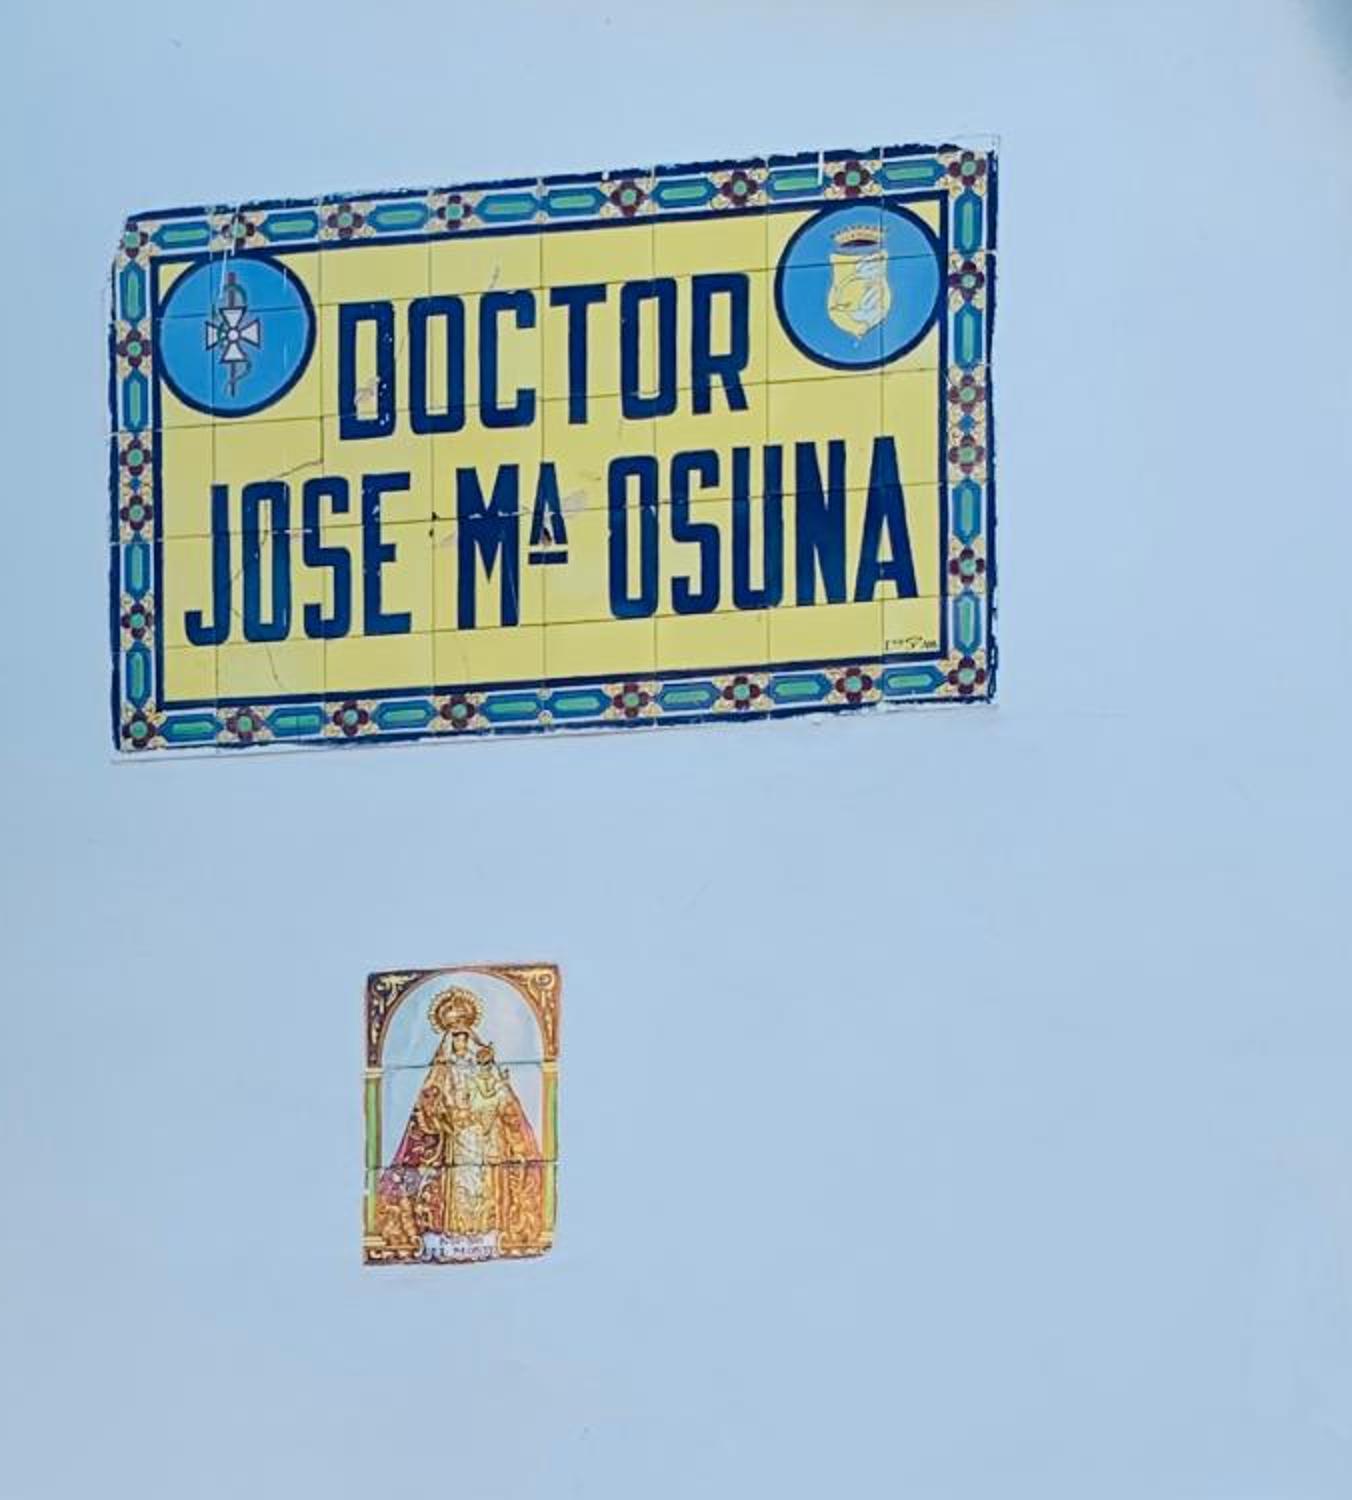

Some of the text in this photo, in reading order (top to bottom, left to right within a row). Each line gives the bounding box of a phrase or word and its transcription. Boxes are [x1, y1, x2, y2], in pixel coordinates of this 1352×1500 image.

[338, 272, 751, 441] DOCTOR
[184, 472, 412, 647] JOSE
[607, 435, 919, 620] OSUNA
